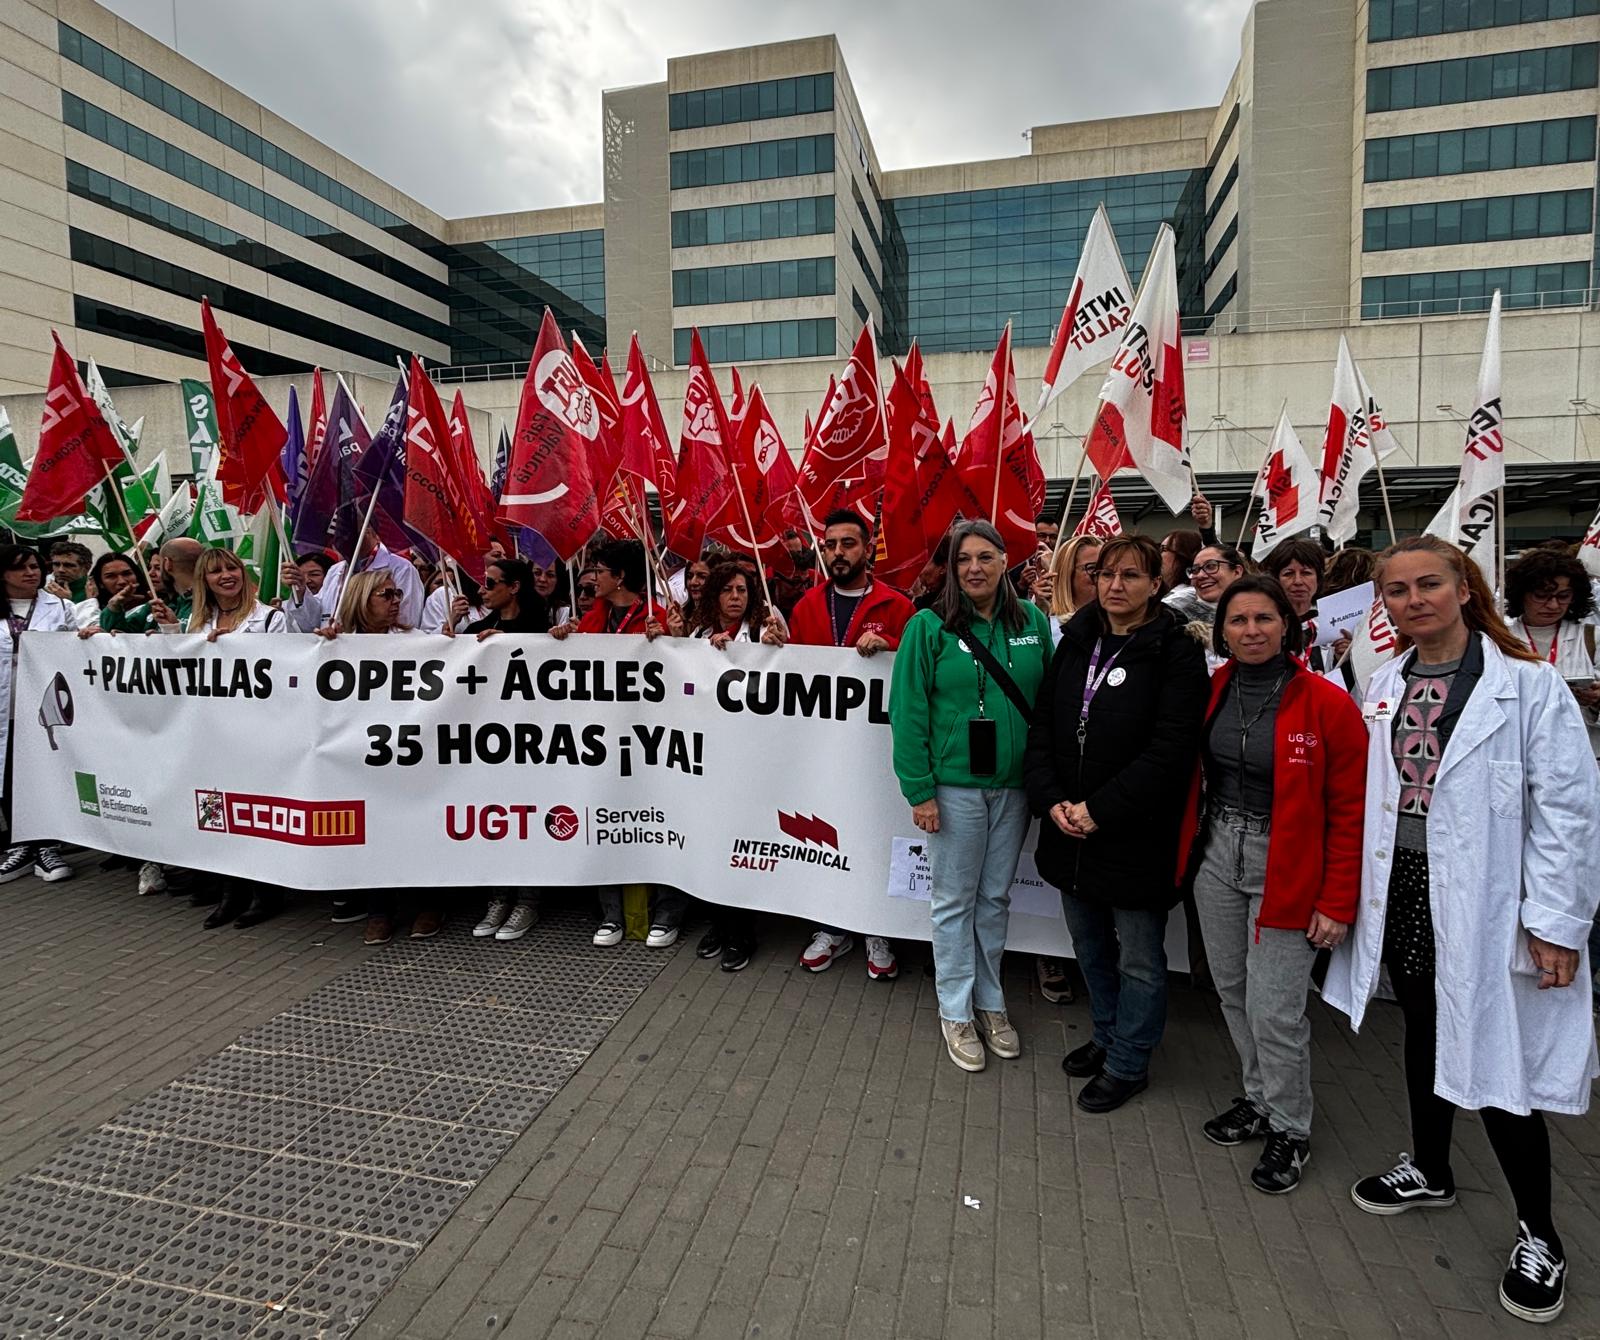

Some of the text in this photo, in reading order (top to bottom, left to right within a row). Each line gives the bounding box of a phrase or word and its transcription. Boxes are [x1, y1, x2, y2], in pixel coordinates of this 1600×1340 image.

[1008, 634, 1040, 647] SATSE
[315, 659, 446, 702] OPES
[500, 647, 666, 703] ÁGILES
[716, 669, 890, 725] CUMPL
[364, 723, 705, 778] 35 HORAS ¡YA!
[99, 782, 132, 799] Sindicato
[232, 802, 307, 837] CCOO
[445, 804, 538, 842] UGT
[595, 806, 666, 825] Serveis
[597, 827, 686, 850] Públics PV
[730, 859, 779, 873] SALUT
[733, 838, 852, 872] INTERSINDICAL
